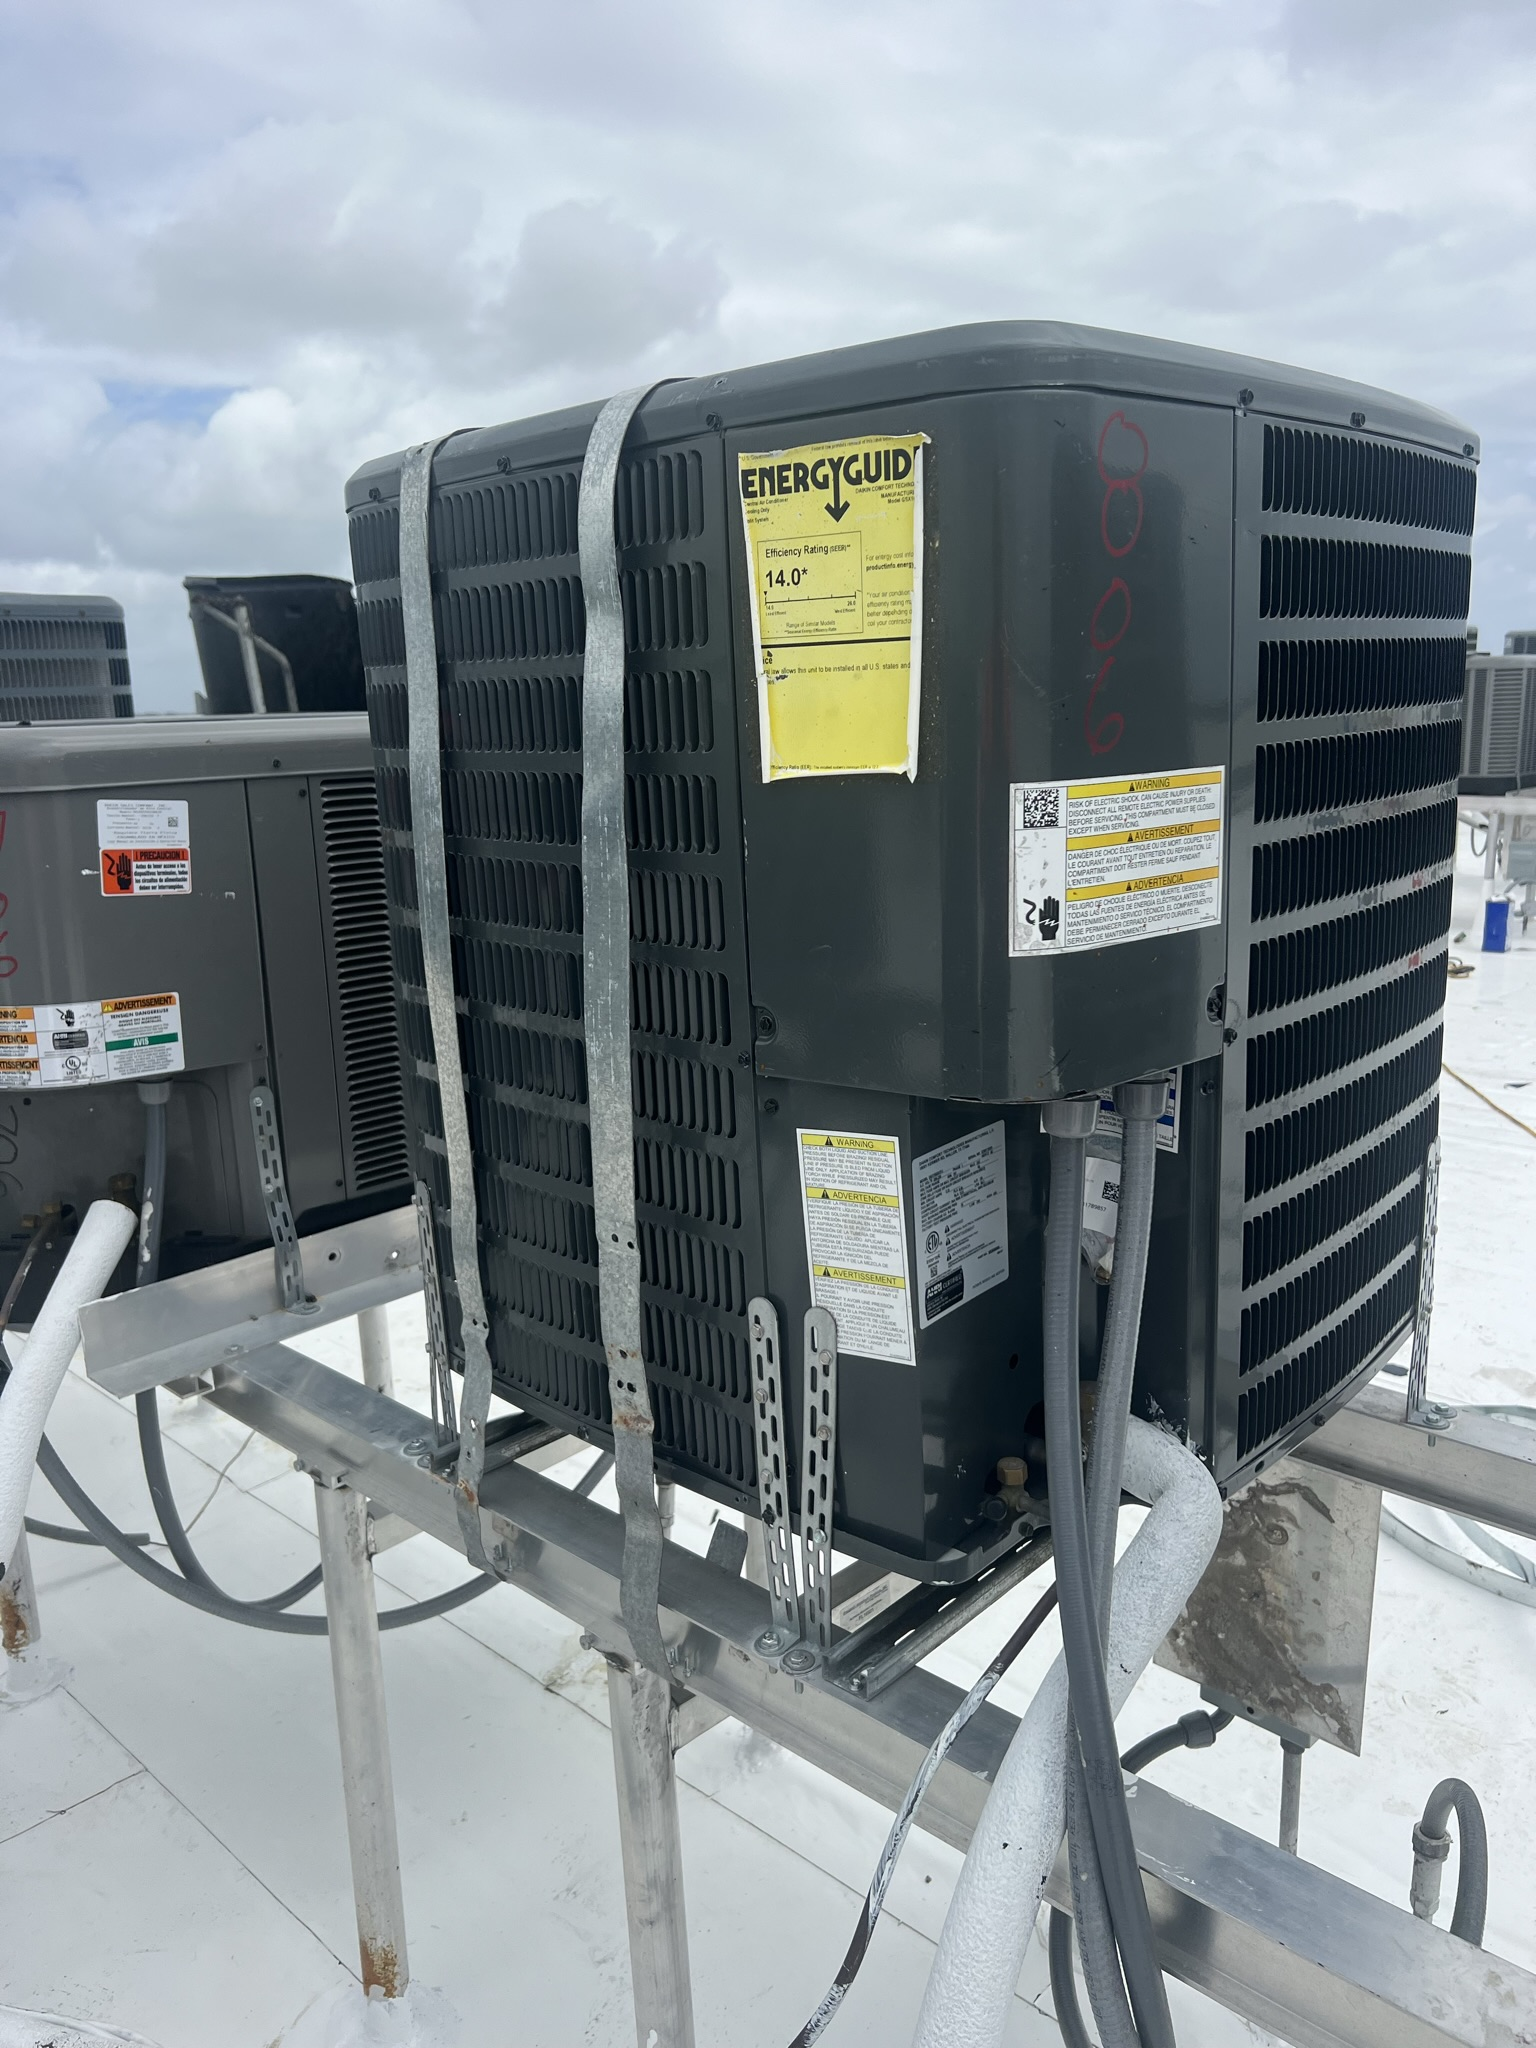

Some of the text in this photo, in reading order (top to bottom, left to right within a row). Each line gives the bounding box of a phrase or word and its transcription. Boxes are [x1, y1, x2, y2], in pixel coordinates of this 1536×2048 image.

[766, 548, 802, 558] Efficiency
[804, 544, 828, 555] Rating
[833, 664, 854, 672] installed
[1135, 778, 1170, 790] WARNING
[1069, 801, 1084, 809] RISK
[1094, 797, 1120, 806] ELECTRIC
[1152, 791, 1169, 799] CAUSE
[1069, 807, 1106, 818] DISCONNECT
[1118, 803, 1140, 812] REMOTE
[1141, 800, 1164, 809] ELECTRIC
[1165, 798, 1183, 806] POWER
[1184, 795, 1206, 804] SUPPLIES
[1069, 817, 1093, 826] BEFORE
[1125, 812, 1137, 820] THIS
[1138, 807, 1175, 818] COMPARTMENT
[1176, 805, 1189, 813] MUST
[1197, 802, 1215, 811] CLOSED
[1069, 826, 1092, 835] EXCEPT
[1094, 824, 1110, 832] WHEN
[1135, 824, 1194, 840] AVERTISSEMENT
[1068, 851, 1093, 861] DANGER
[1103, 847, 1118, 856] CHOC
[1183, 836, 1203, 844] COUPEZ
[1068, 865, 1113, 878] COMPARTIMENT
[1114, 863, 1126, 871] DOIT
[1127, 860, 1147, 869] RESTER
[1179, 852, 1201, 861] PENDANT
[1078, 858, 1105, 868] COURANT
[1106, 855, 1123, 864] AVANT
[1124, 853, 1138, 861] TOUT
[1139, 849, 1166, 859] ENTRETIEN
[1133, 874, 1184, 890] ADVERTENCIA
[1068, 901, 1094, 911] PELIGRO
[1095, 899, 1103, 907] DE
[1103, 895, 1126, 905] CHOQUE
[1182, 881, 1213, 892] DESCONECTE
[1068, 910, 1088, 920] TODAS
[1090, 908, 1100, 916] LAS
[1101, 904, 1125, 914] FUENTES
[1183, 892, 1198, 900] ANTES
[1068, 914, 1113, 928] MANTENIMIENTO
[1173, 897, 1213, 910] COMPARTIMENTO
[1067, 927, 1084, 937] DEBE
[1086, 921, 1122, 934] PERMANECER
[1123, 916, 1147, 927] CERRADO
[1148, 912, 1170, 922] EXCEPTO
[1171, 908, 1193, 918] DURANTE
[1067, 934, 1096, 945] SERVICIO
[134, 1037, 149, 1047] AVIS
[836, 1138, 874, 1148] WARNING
[832, 1192, 887, 1204] ADVERTENCIA
[832, 1269, 897, 1285] AVERTISSEMENT
